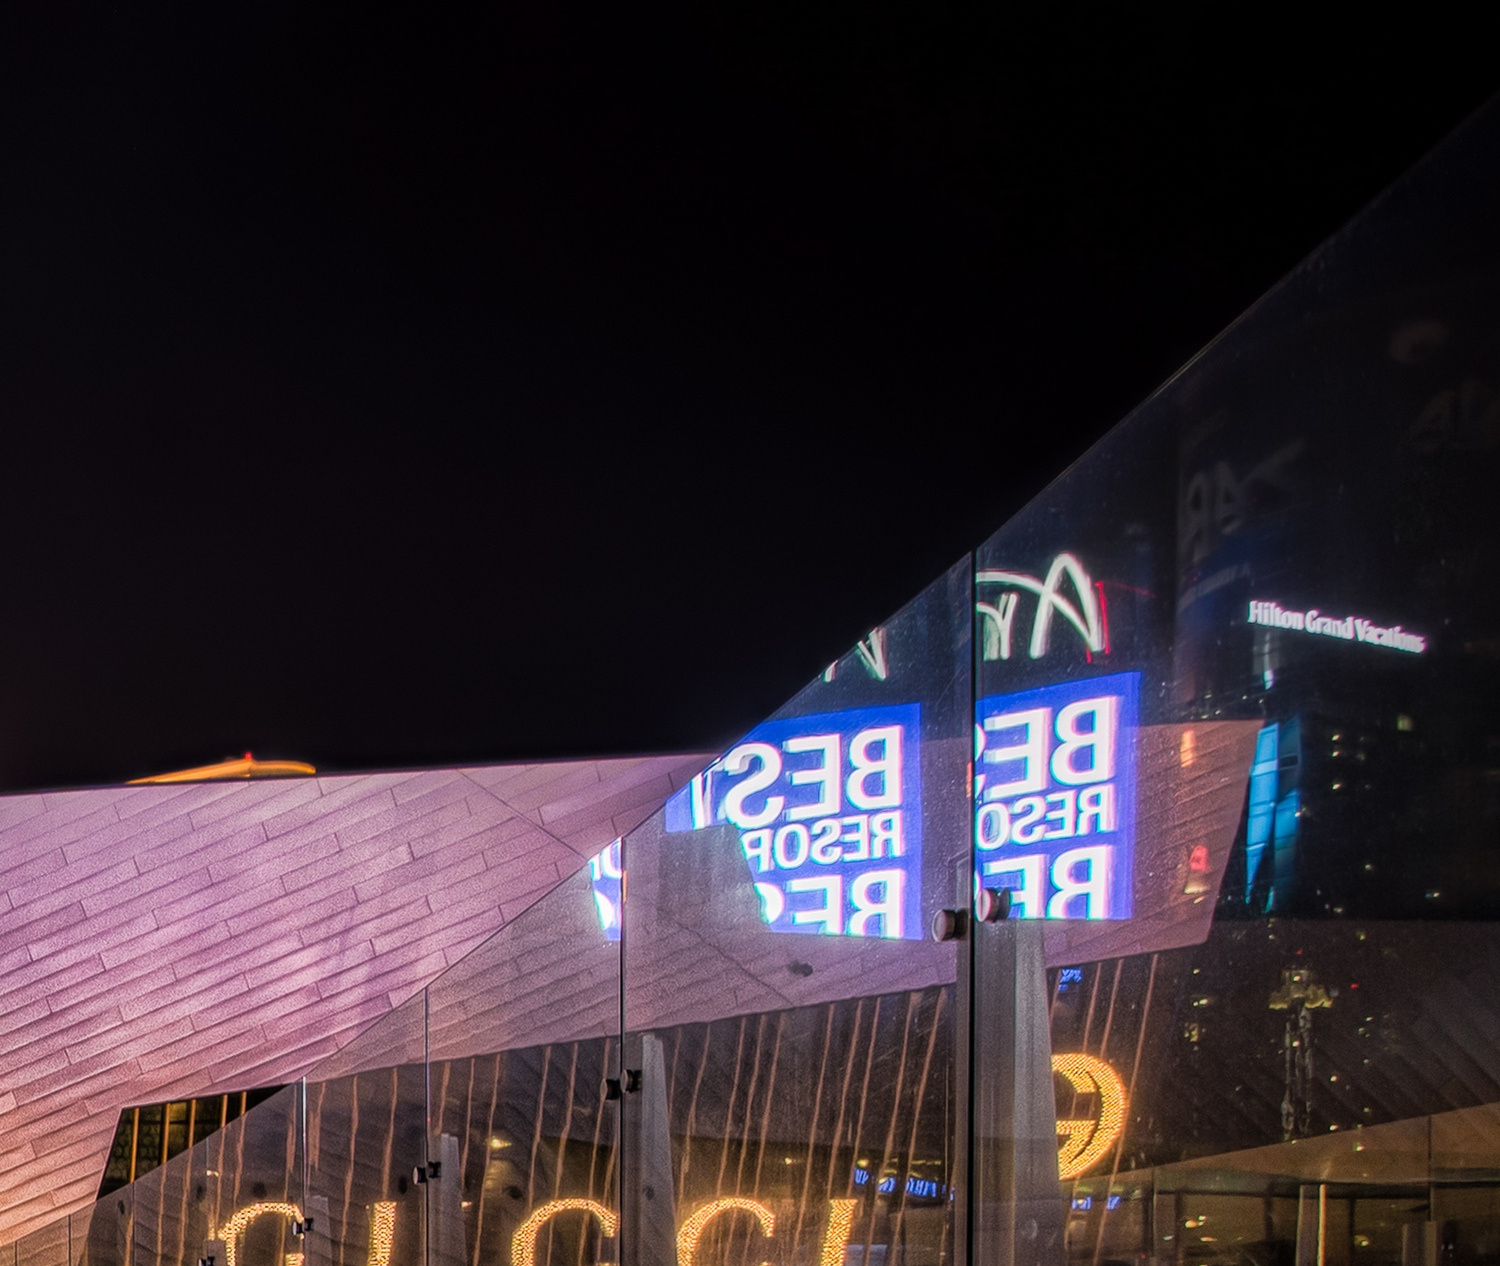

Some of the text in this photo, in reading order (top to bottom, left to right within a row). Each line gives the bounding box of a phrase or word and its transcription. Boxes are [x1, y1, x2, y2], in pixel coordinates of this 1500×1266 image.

[1248, 600, 1427, 653] Hilton Grand Vacations
